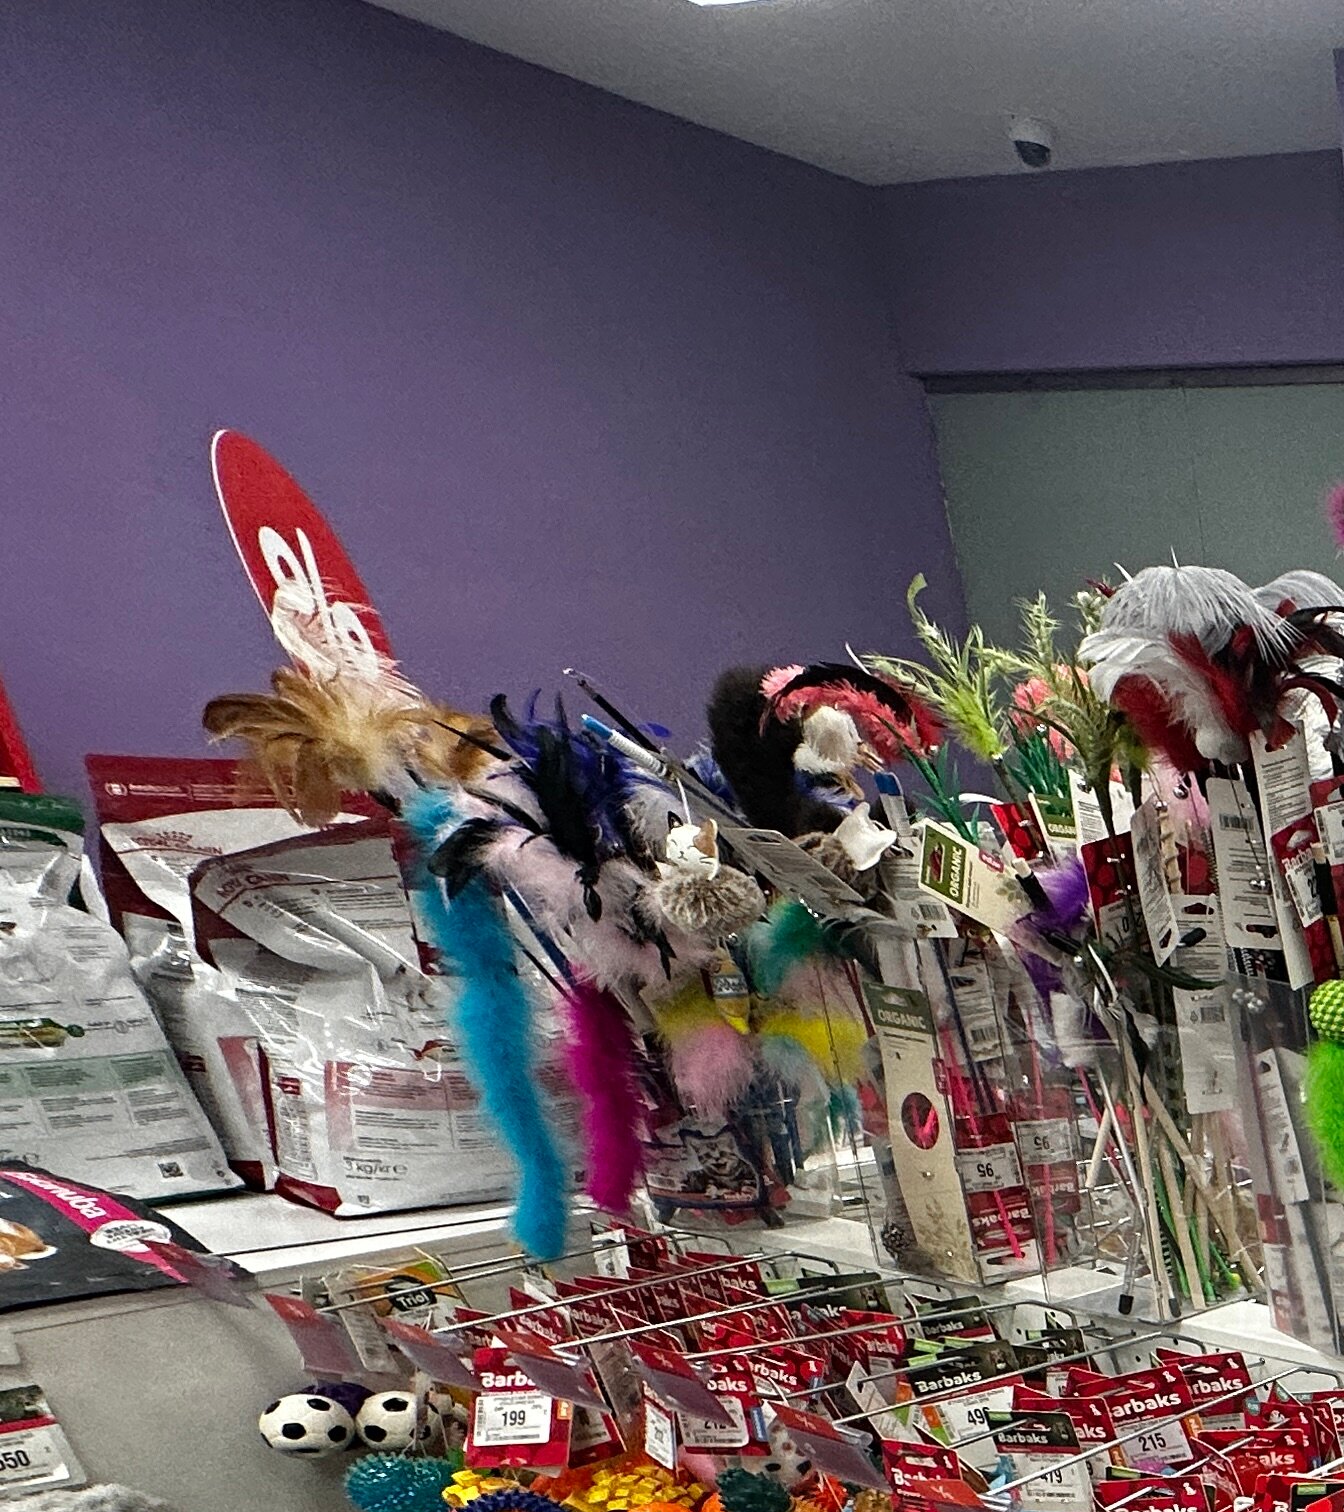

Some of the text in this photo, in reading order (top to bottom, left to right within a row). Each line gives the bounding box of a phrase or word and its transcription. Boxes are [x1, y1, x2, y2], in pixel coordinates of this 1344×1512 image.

[949, 844, 964, 902] ORGANIC
[877, 1009, 926, 1030] ORGANIC
[977, 1162, 994, 1178] 95
[722, 1274, 757, 1291] baks
[396, 1290, 430, 1314] Triol
[915, 1370, 983, 1393] Barbaks
[1190, 1376, 1244, 1394] rbaks
[1111, 1391, 1183, 1419] arbaks
[500, 1409, 527, 1428] 199
[998, 1430, 1049, 1446] Barbaks
[1137, 1432, 1167, 1452] 215
